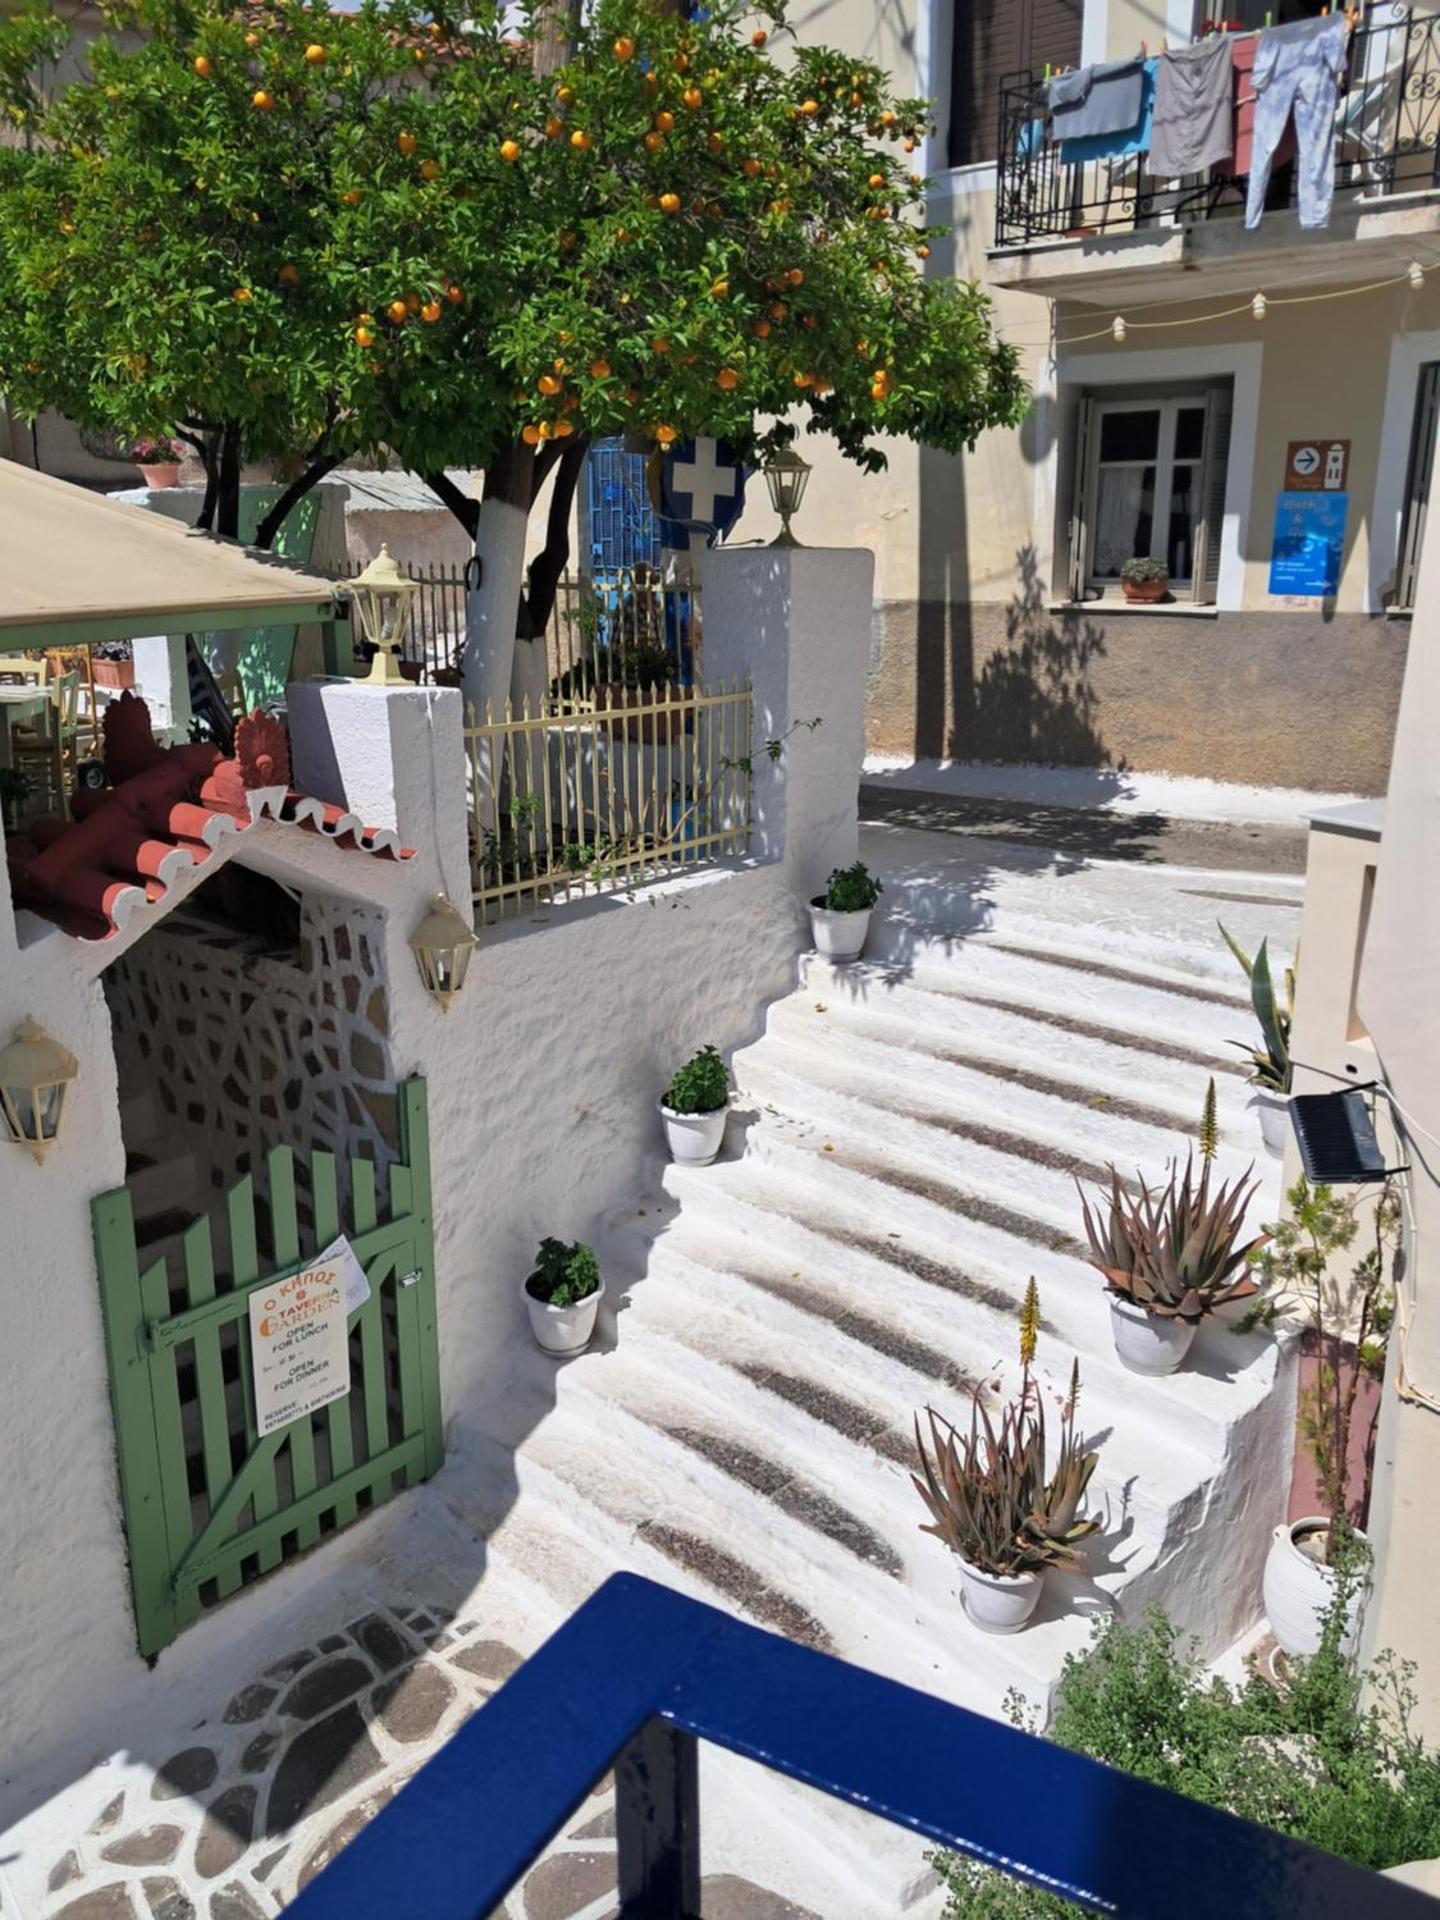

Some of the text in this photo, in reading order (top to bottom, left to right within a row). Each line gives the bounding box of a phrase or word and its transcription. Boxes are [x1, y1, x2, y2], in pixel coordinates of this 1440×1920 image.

[280, 1287, 339, 1318] TAVERNA
[272, 1323, 328, 1353] FOR LUNCH
[286, 1321, 314, 1338] OPEN
[274, 1378, 294, 1392] FOR
[296, 1360, 329, 1382] DINNER
[289, 1359, 314, 1376] OPEN
